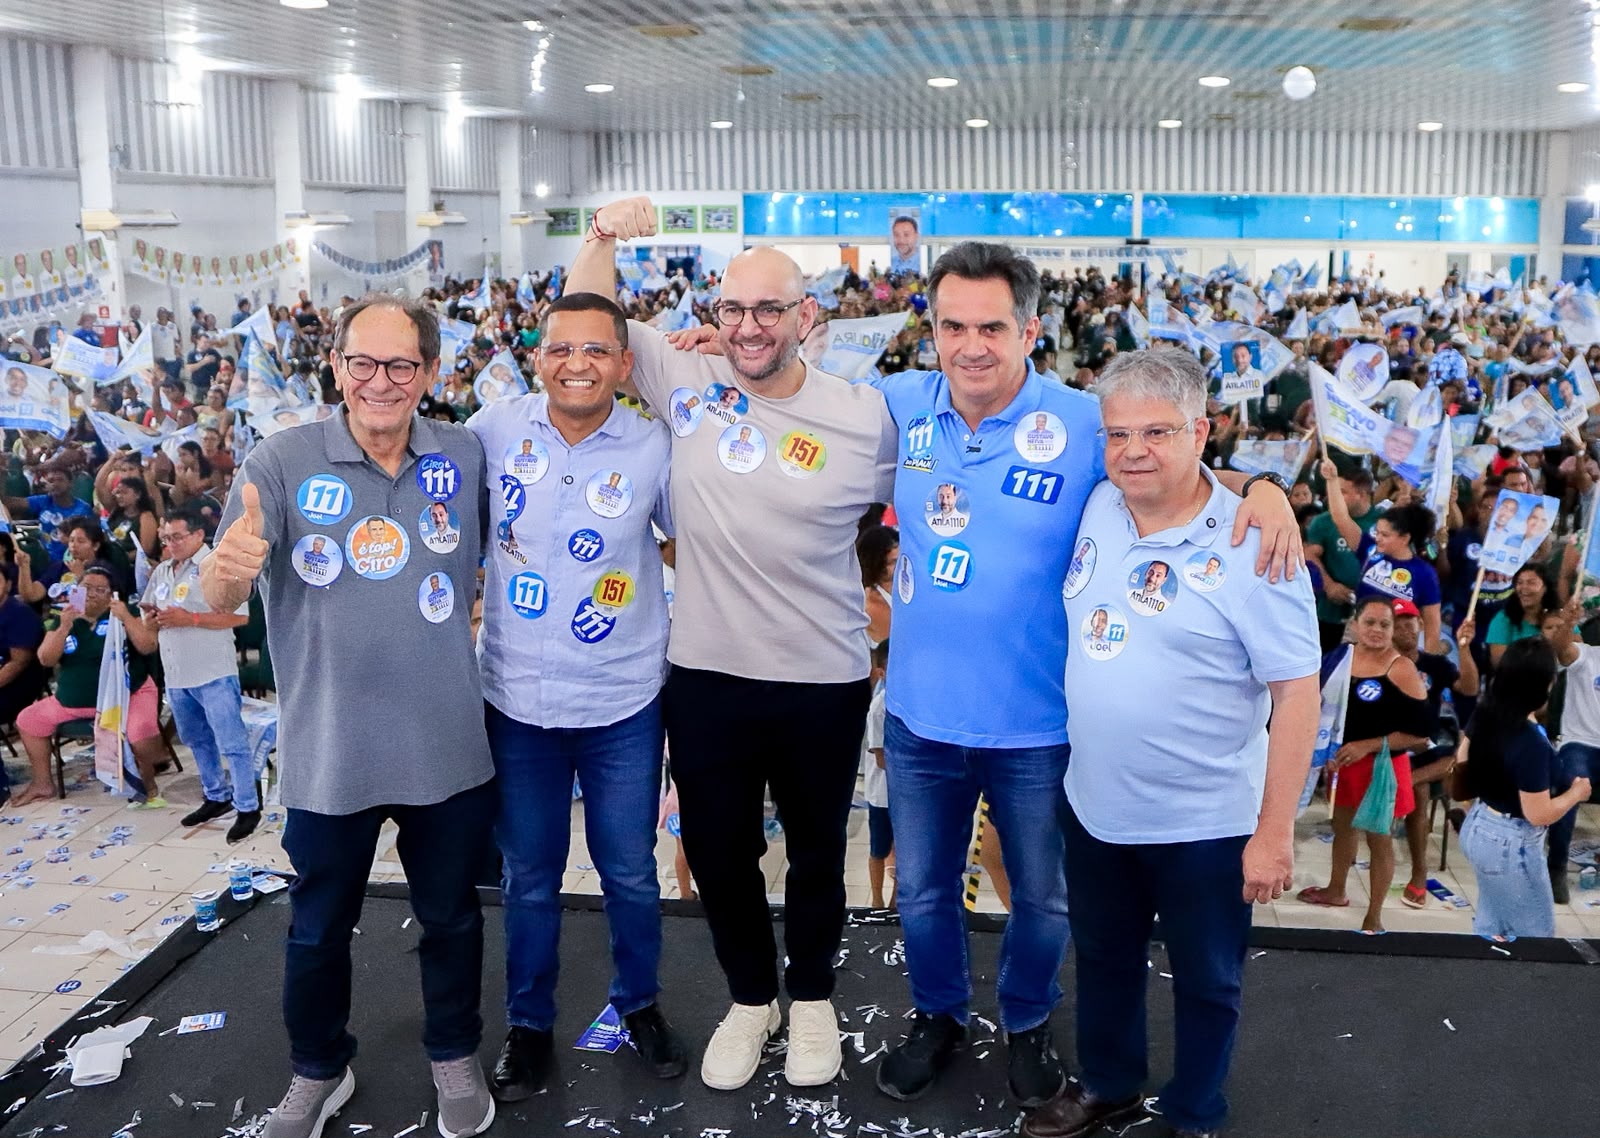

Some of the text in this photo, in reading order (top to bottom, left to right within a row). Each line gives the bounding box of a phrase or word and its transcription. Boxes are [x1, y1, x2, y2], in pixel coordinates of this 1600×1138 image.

[907, 422, 934, 453] 111
[788, 437, 819, 466] 151
[422, 468, 455, 494] 111
[1012, 470, 1057, 501] 111
[313, 484, 340, 510] 11
[572, 537, 600, 558] 111
[941, 552, 965, 578] 11
[519, 581, 540, 606] 11
[602, 578, 627, 603] 151
[1111, 626, 1123, 640] 11
